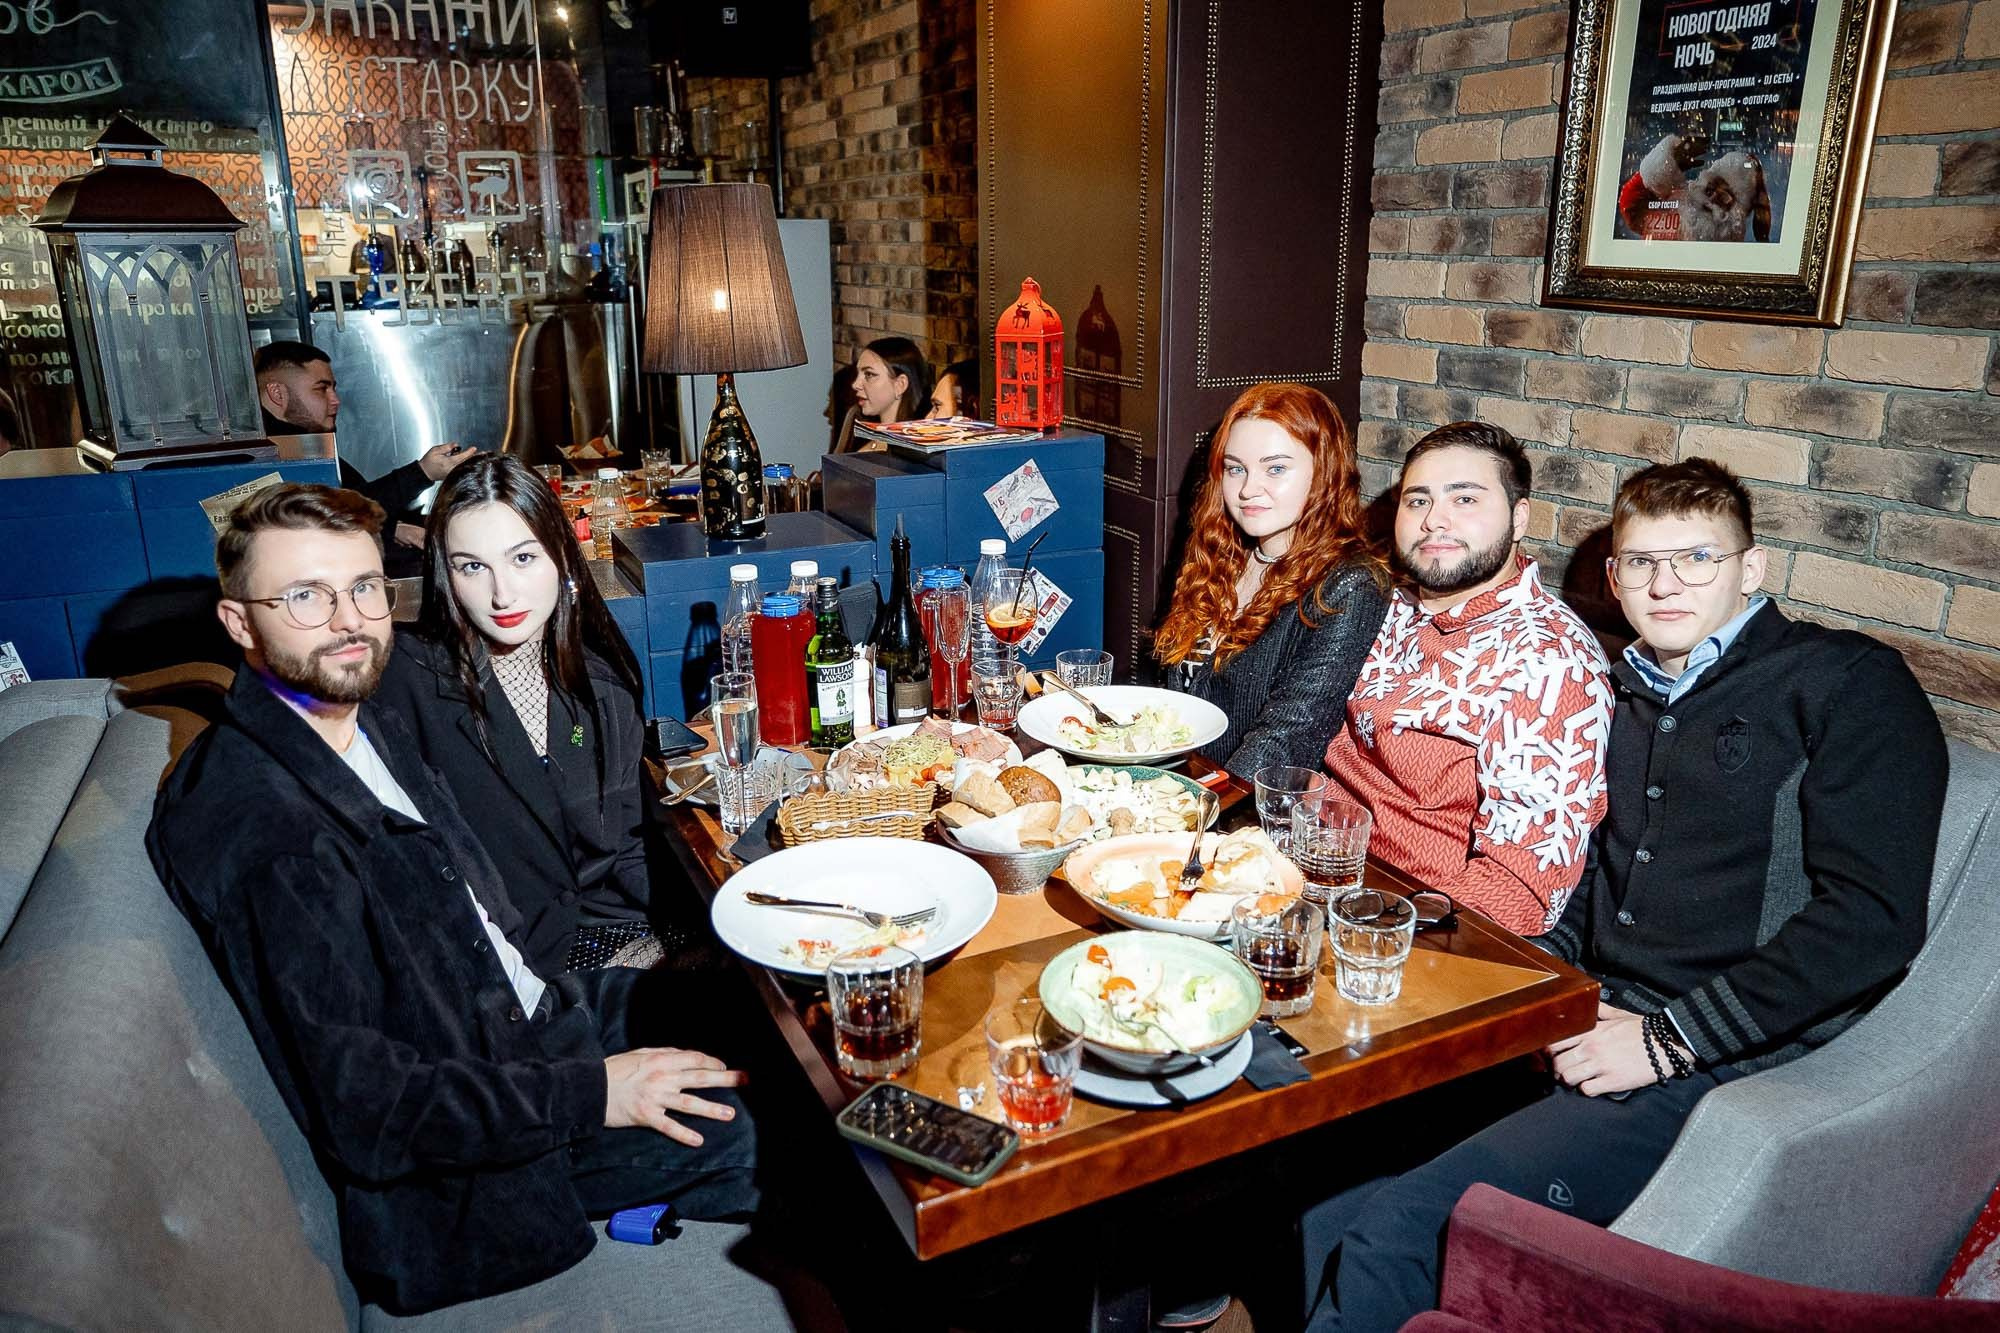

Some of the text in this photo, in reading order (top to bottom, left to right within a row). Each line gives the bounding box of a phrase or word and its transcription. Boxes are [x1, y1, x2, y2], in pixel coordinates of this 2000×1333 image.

[1668, 2, 1771, 39] НОВОГОДНЯЯ
[1751, 34, 1777, 50] 2024
[1674, 42, 1716, 68] НОЧЬ
[1652, 83, 1698, 97] ПРАЗДНИЧНАЯ
[1698, 76, 1756, 92] ШОУ-ПРОГРАММА
[1773, 73, 1794, 85] СЕТЫ
[1682, 100, 1700, 111] ДУЭТ
[1742, 94, 1780, 106] ФОТОГРАФ
